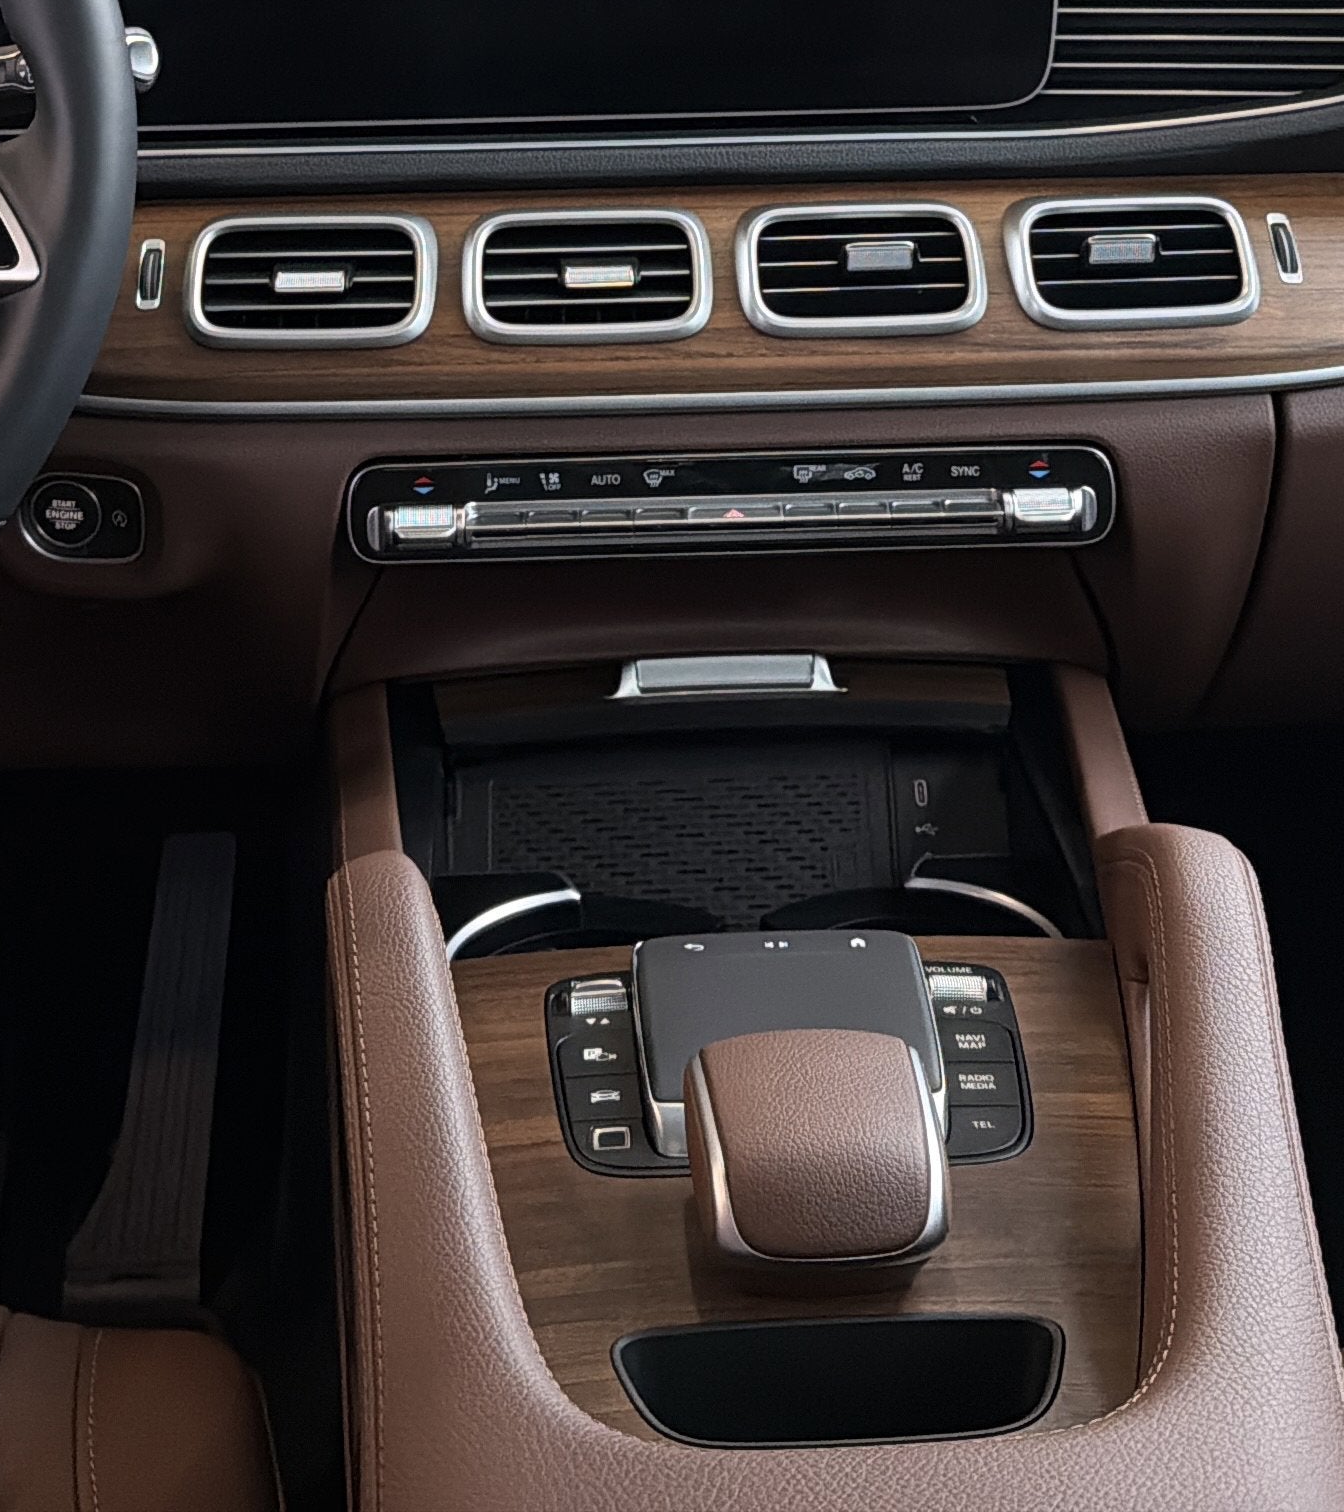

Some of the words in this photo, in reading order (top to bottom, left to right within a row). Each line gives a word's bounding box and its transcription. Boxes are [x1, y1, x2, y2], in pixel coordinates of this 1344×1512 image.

[660, 469, 676, 478] MAX
[901, 462, 924, 475] A/C
[950, 465, 981, 478] SYNC
[499, 475, 521, 485] MENU
[591, 473, 621, 486] AUTO
[51, 498, 77, 508] START
[45, 508, 85, 521] ENGINE
[54, 521, 77, 531] STOP
[924, 965, 974, 975] VOLUME
[955, 1033, 986, 1042] NAVI
[958, 1041, 987, 1050] MAP
[958, 1073, 996, 1083] RADIO
[960, 1081, 997, 1090] MEDIA
[971, 1120, 996, 1130] TEL
